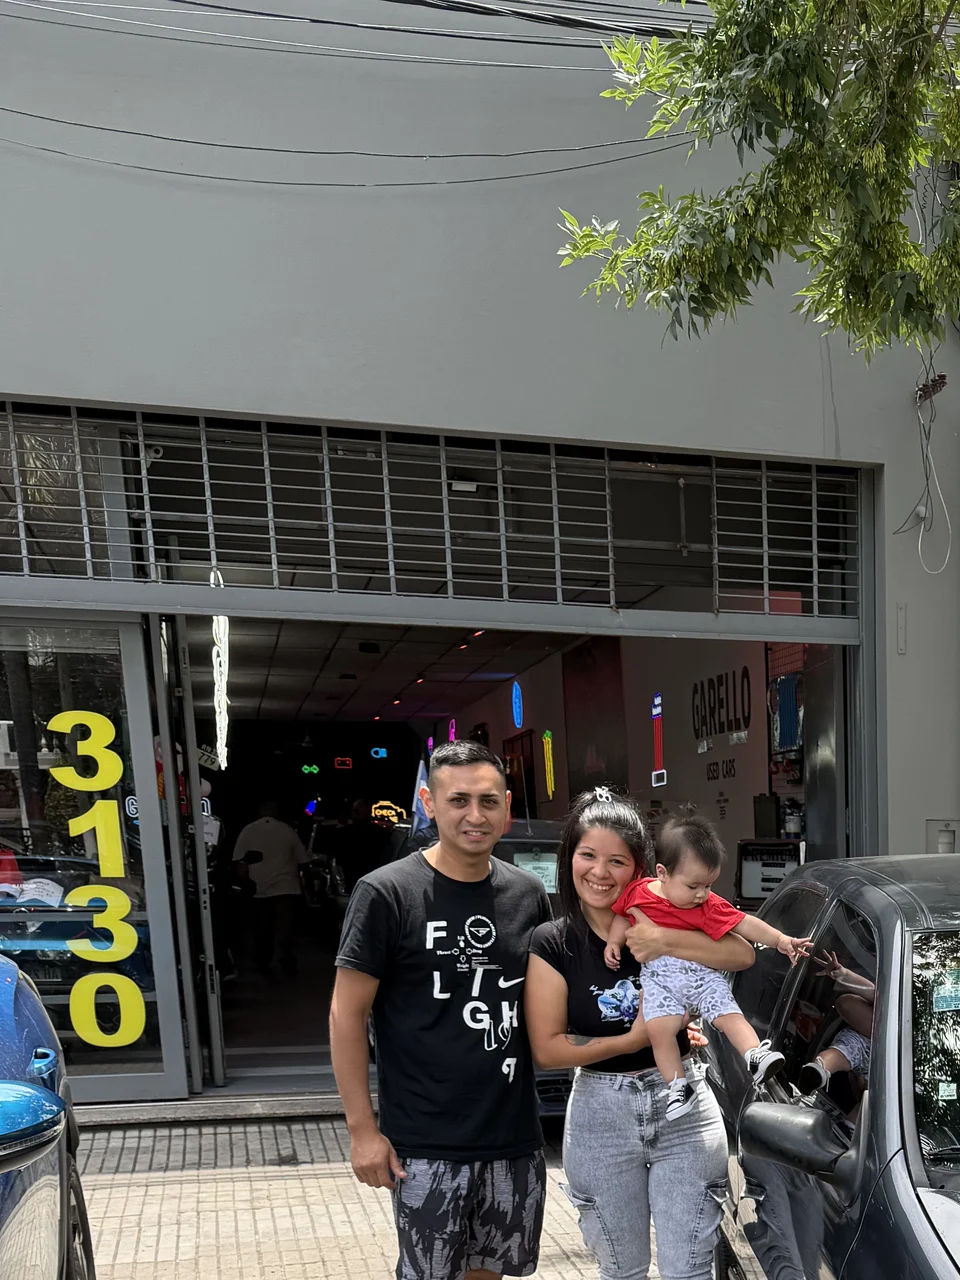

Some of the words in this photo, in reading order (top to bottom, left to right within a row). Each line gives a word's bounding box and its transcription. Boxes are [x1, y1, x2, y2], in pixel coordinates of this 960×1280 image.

[691, 665, 752, 740] GARELLO
[706, 761, 720, 781] USED
[721, 758, 736, 779] CARS
